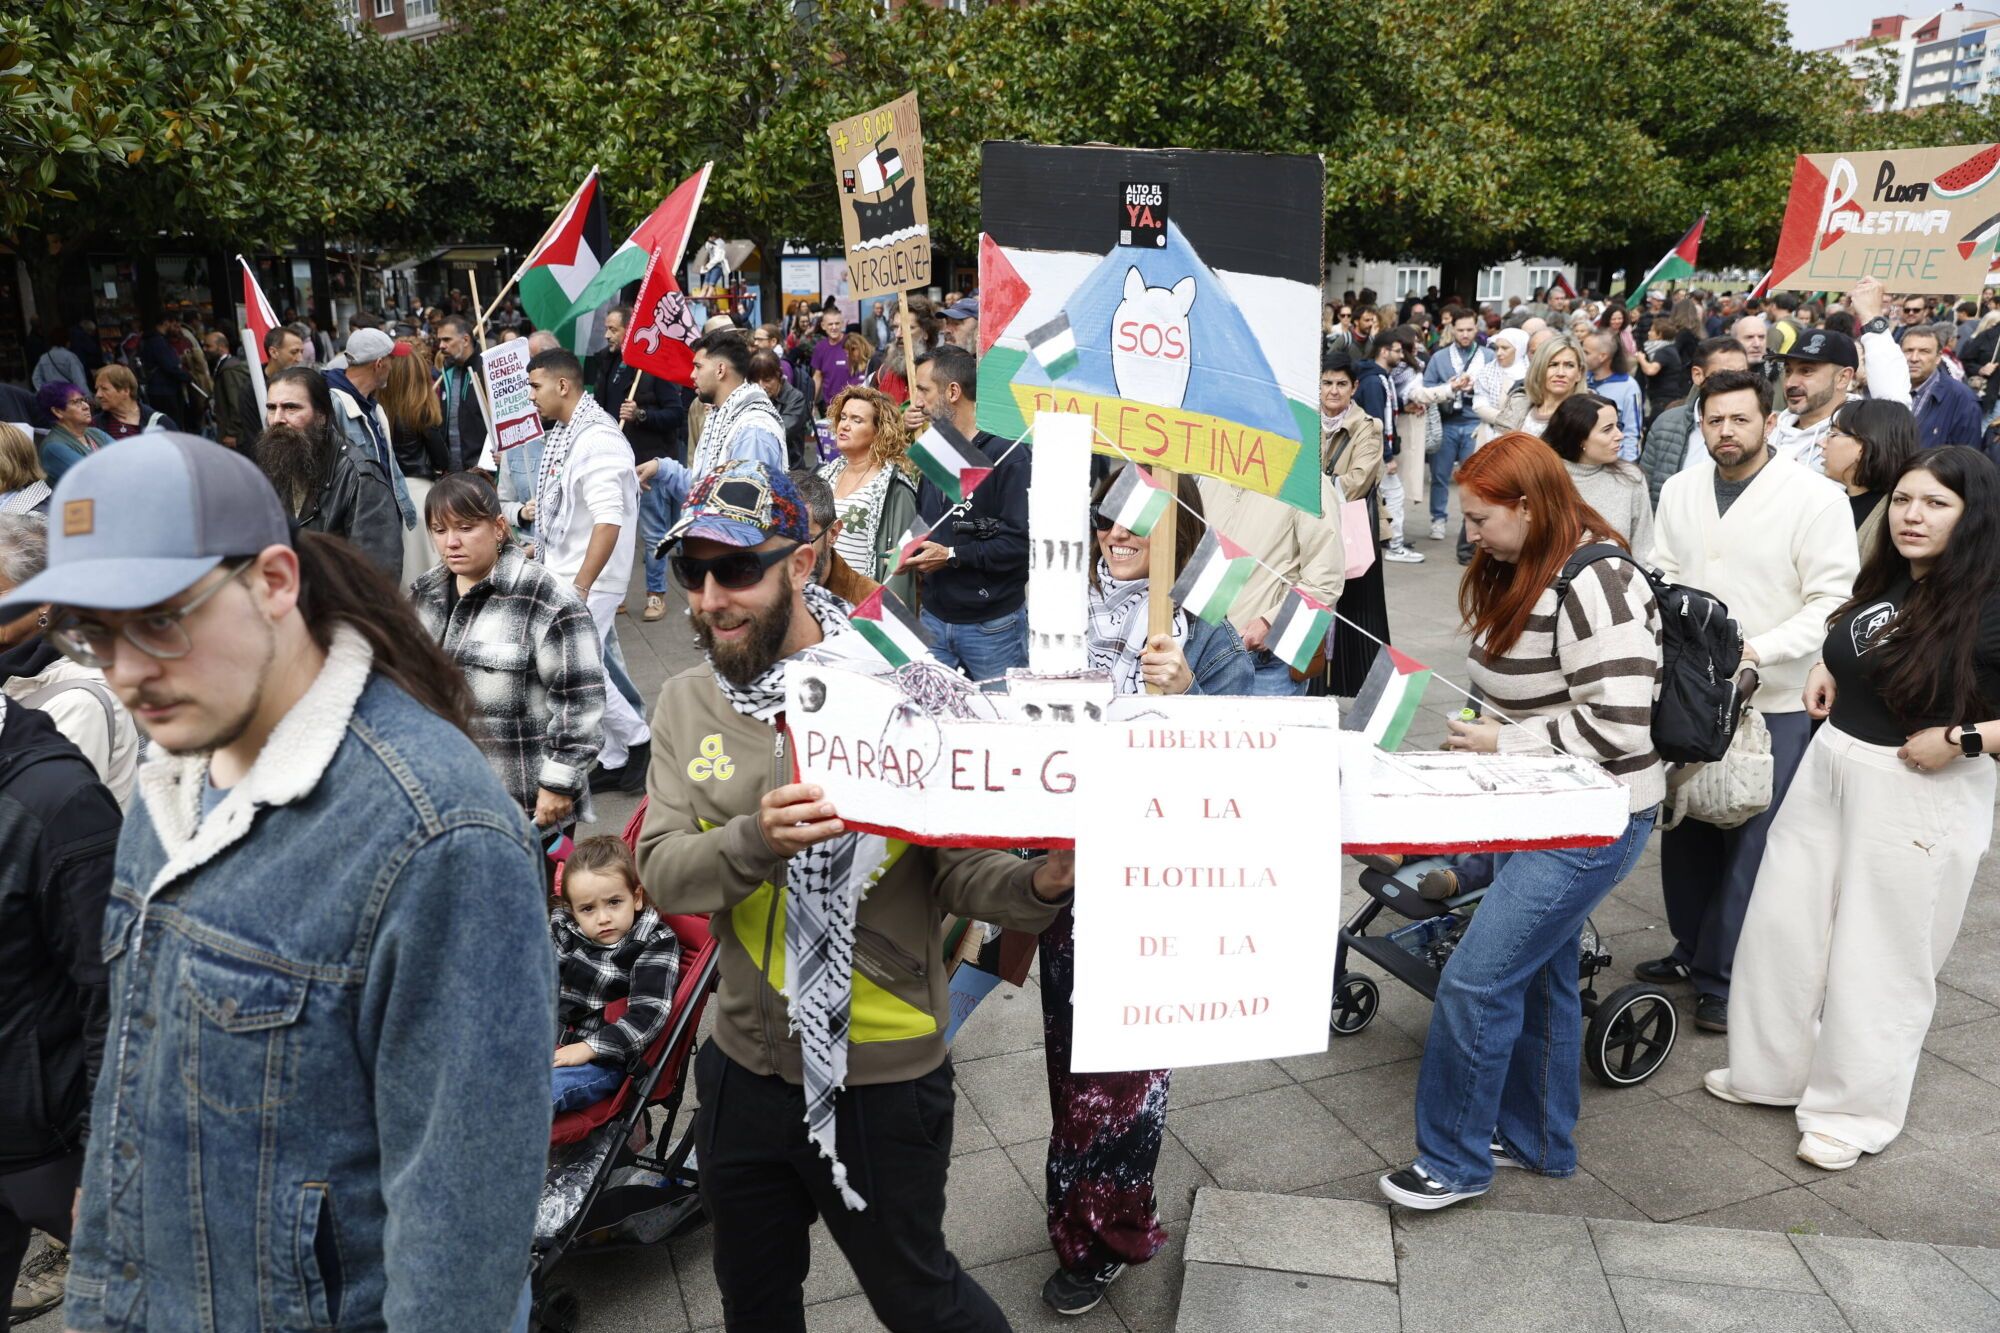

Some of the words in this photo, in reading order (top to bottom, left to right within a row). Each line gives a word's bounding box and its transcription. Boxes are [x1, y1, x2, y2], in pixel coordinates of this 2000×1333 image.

[1126, 184, 1149, 194] ALTO
[1151, 185, 1162, 194] EL
[1126, 194, 1162, 206] FUEGO
[1126, 205, 1162, 228] YA.
[637, 245, 662, 302] Estudiantes
[849, 244, 930, 292] VERGÜENZA
[488, 351, 518, 371] HUELGA
[490, 361, 524, 381] GENERAL
[492, 375, 517, 390] CONTRA
[495, 400, 503, 410] AL
[504, 389, 529, 406] PUEBLO
[1128, 729, 1277, 749] LIBERTAD
[807, 730, 925, 790] PARAR
[1144, 797, 1165, 818] A
[1202, 798, 1242, 819] LA
[1124, 866, 1278, 888] FLOTILLA
[1138, 936, 1178, 957] DE
[1218, 935, 1257, 956] LA
[1122, 996, 1270, 1026] DIGNIDAD
